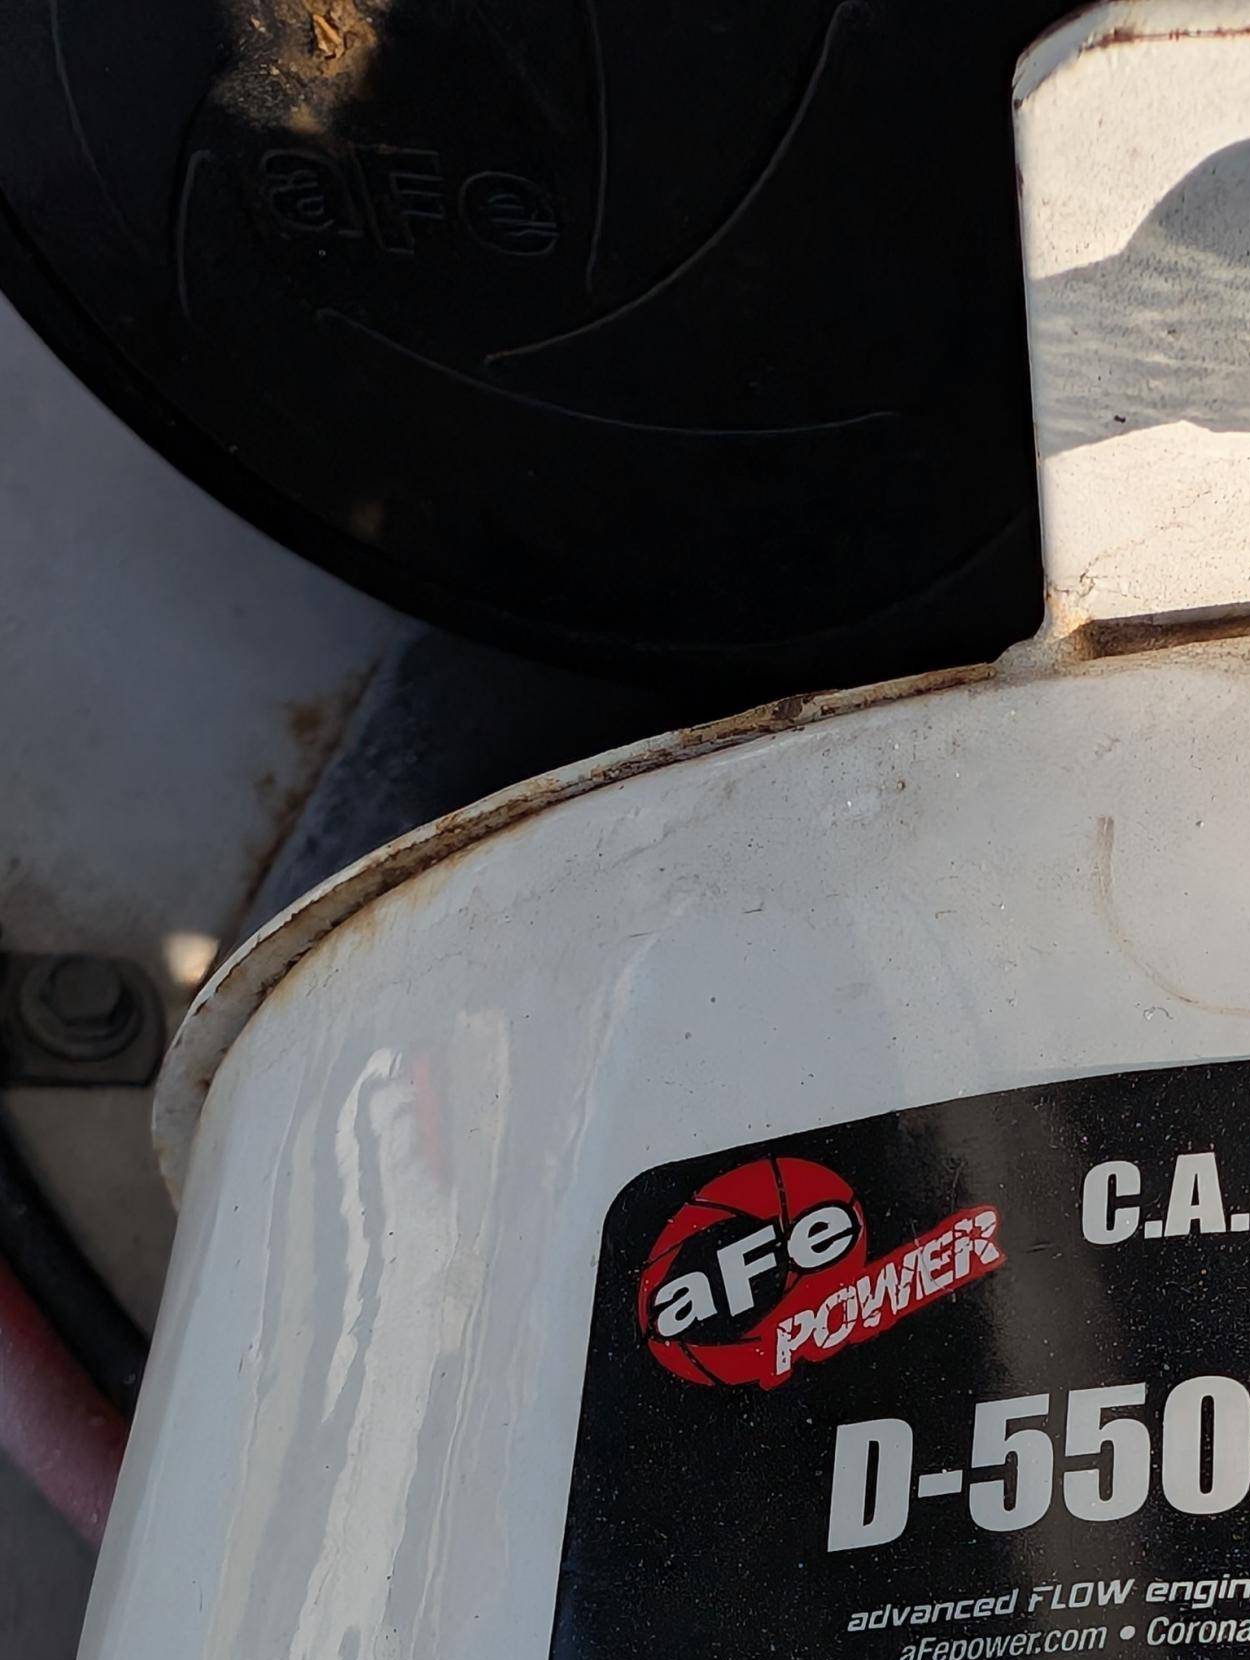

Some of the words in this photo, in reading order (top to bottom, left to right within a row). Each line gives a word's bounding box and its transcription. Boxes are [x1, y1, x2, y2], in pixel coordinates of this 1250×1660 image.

[258, 143, 560, 256] aFe
[655, 1206, 852, 1337] aFe
[775, 1211, 1000, 1376] POWER
[847, 1590, 1019, 1632] advanced
[1028, 1579, 1136, 1612] FLOW
